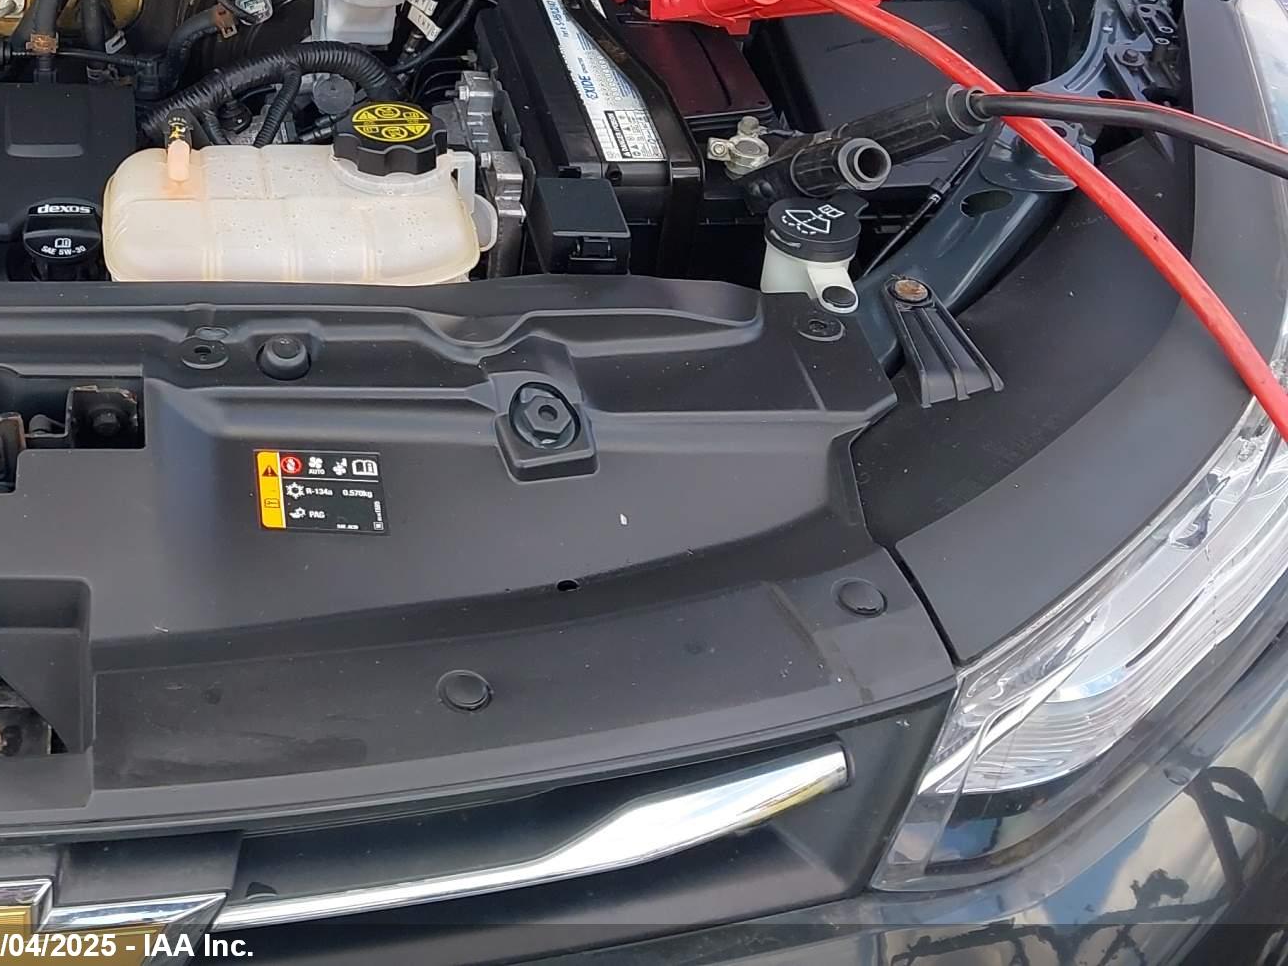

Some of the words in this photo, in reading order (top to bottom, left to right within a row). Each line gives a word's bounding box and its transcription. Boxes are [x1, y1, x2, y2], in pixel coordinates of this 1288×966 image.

[579, 74, 598, 100] EXIDE
[37, 204, 91, 213] dexos
[41, 245, 57, 255] SAE
[58, 245, 86, 255] 5W-30
[305, 487, 333, 495] R-134a
[342, 489, 373, 498] 0.570kg
[309, 510, 325, 518] PAG
